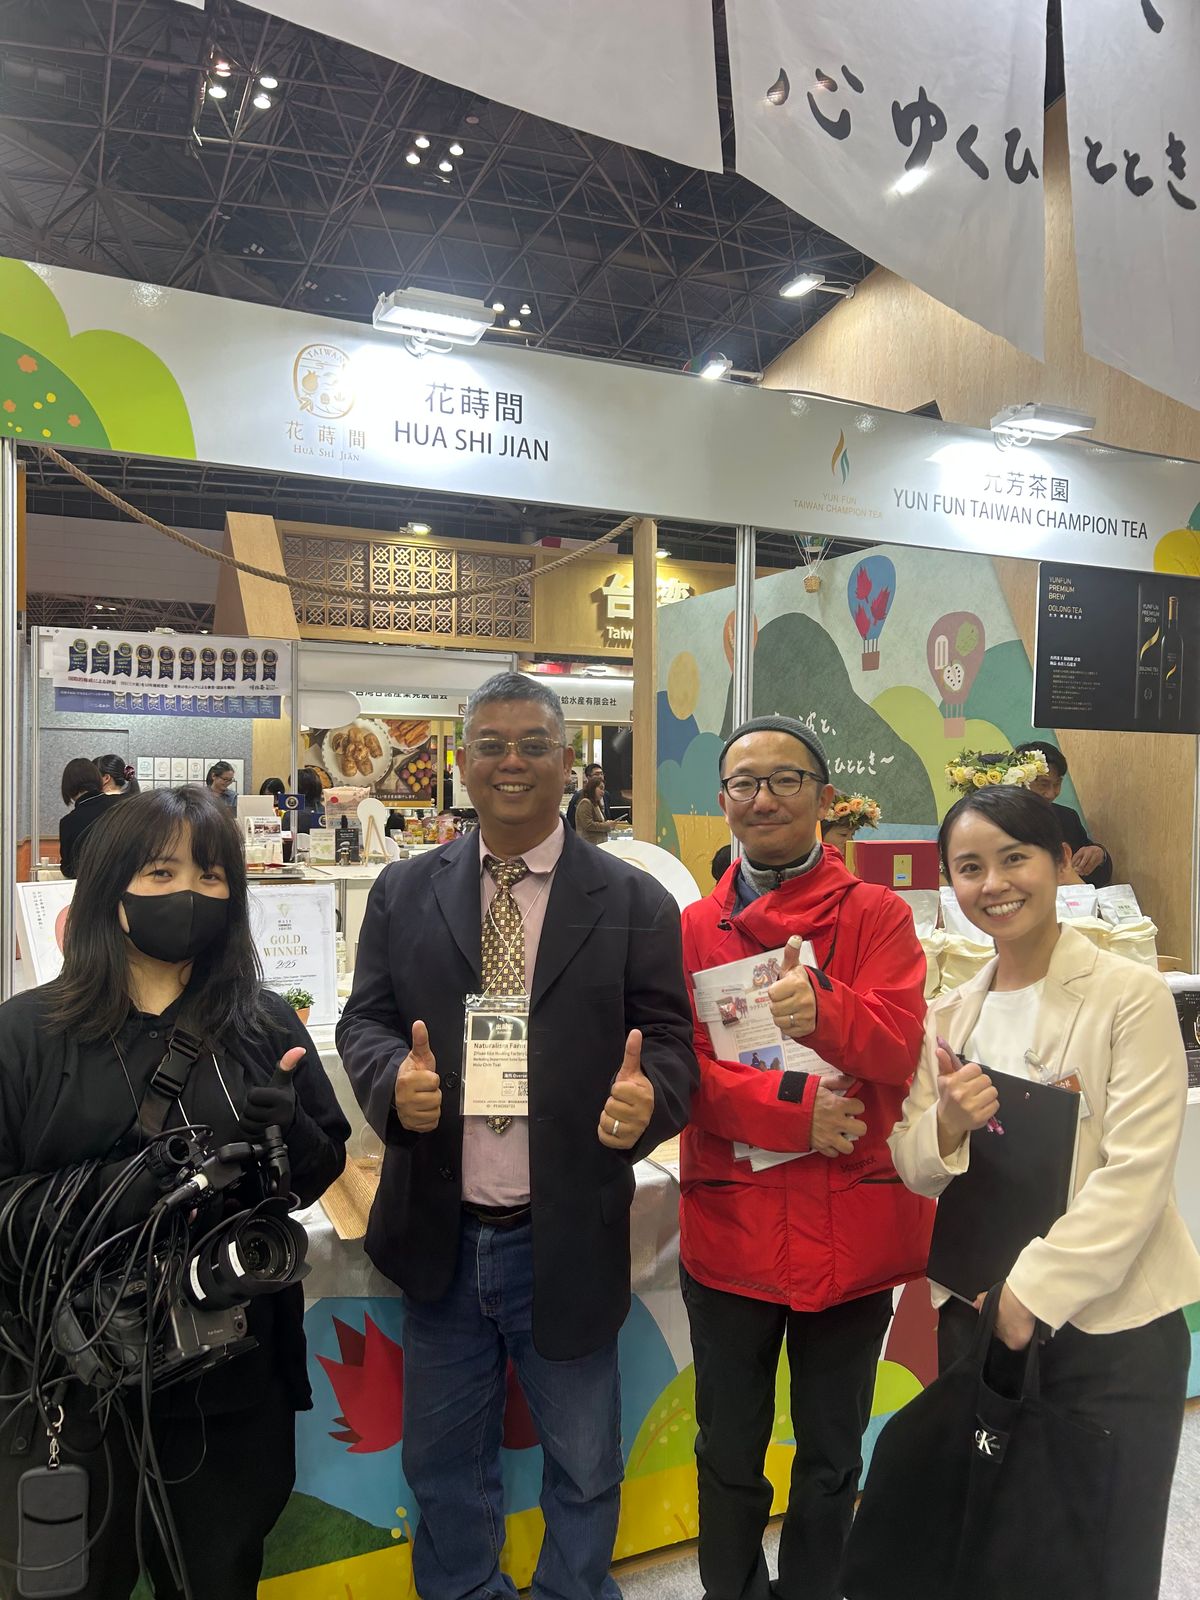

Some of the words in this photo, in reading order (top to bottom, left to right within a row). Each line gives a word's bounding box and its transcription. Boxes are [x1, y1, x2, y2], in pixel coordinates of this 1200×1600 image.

[425, 382, 522, 424] 花蒔間
[395, 420, 447, 448] HUA
[455, 429, 491, 454] SHI
[499, 435, 549, 461] JIAN
[794, 500, 824, 511] TAIWAN
[826, 504, 867, 516] CHAMPION
[893, 487, 928, 511] YUN
[933, 494, 965, 516] FUN
[970, 499, 1031, 525] TAIWAN
[1036, 509, 1118, 536] CHAMPION
[1121, 520, 1148, 539] TEA
[1049, 584, 1075, 592] PREMIUM
[1048, 592, 1066, 600] BREW
[1048, 604, 1071, 613] OOLONG
[1072, 606, 1083, 614] TEA
[606, 626, 634, 639] Taiw
[270, 934, 301, 945] GOLD
[263, 945, 308, 957] WINNER
